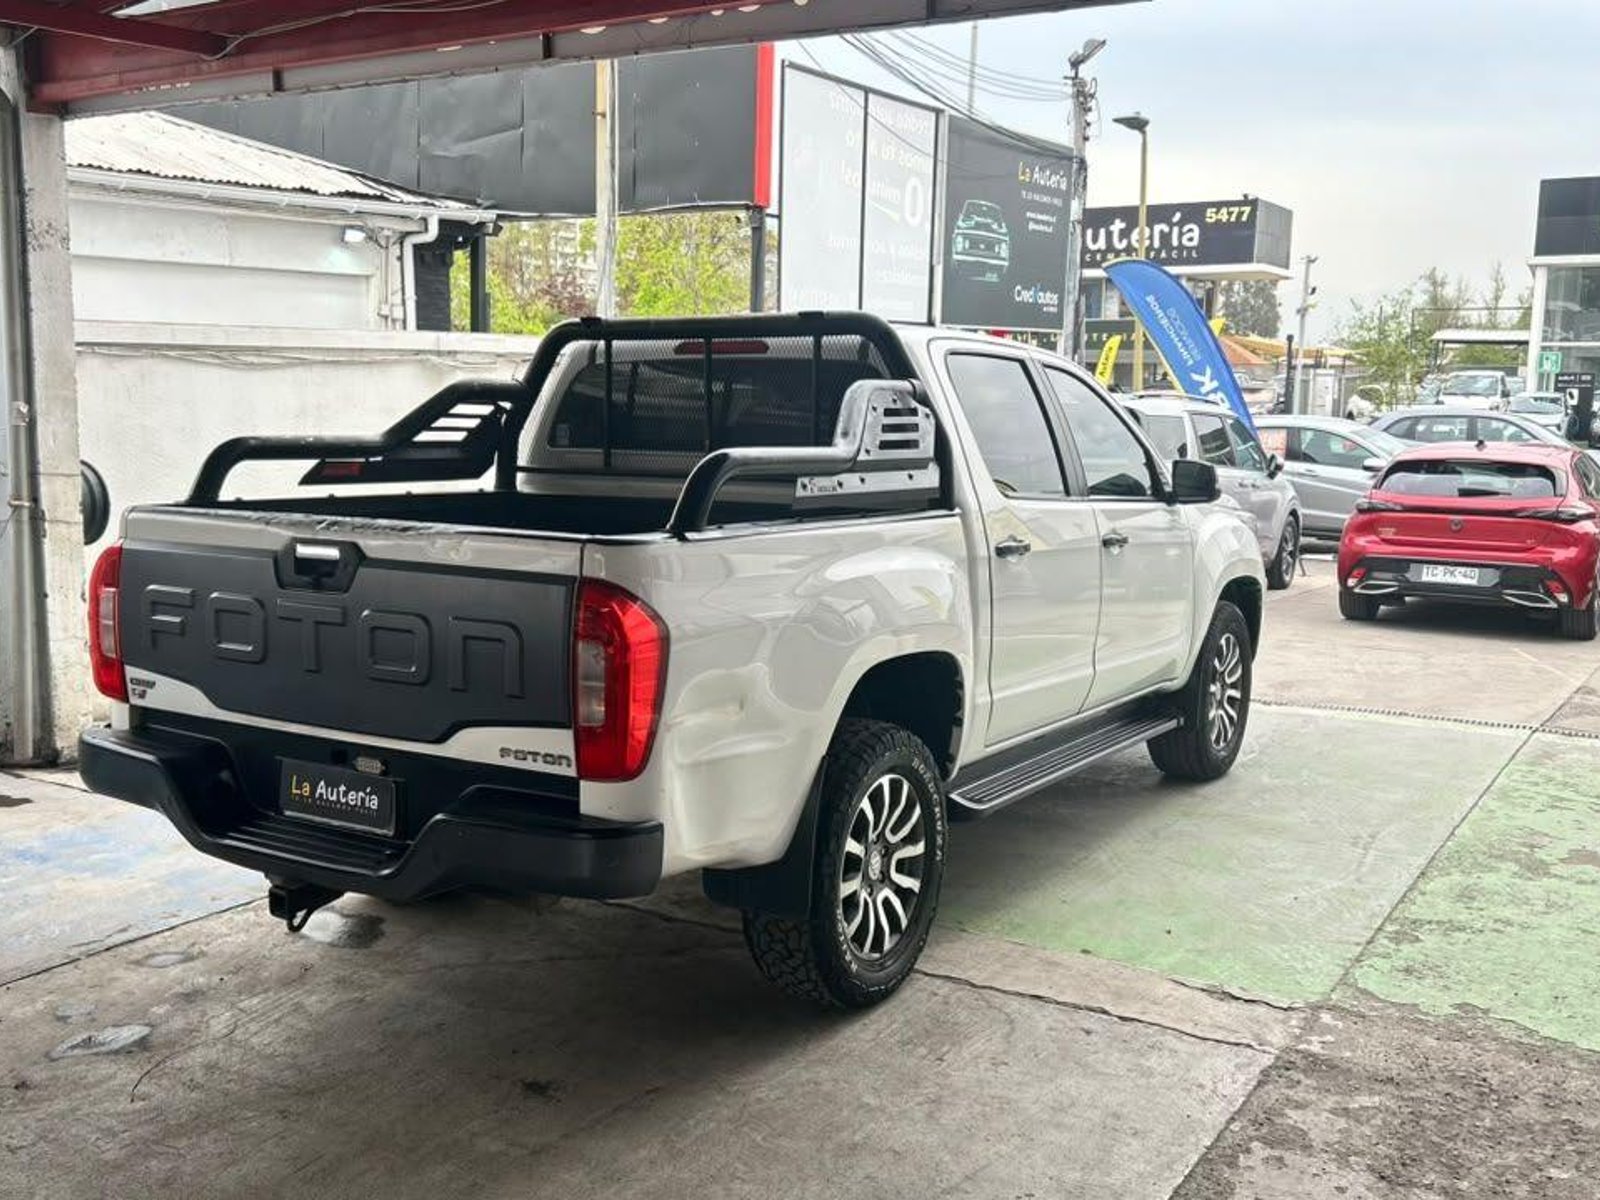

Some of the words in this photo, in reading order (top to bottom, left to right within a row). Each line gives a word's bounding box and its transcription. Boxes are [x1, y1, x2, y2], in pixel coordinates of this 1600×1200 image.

[1018, 161, 1031, 182] La
[1205, 205, 1252, 224] 5477
[1086, 212, 1200, 250] utería
[143, 583, 526, 699] FOTON
[499, 747, 572, 768] FOTON
[291, 775, 310, 796] La
[315, 780, 379, 810] Autería
